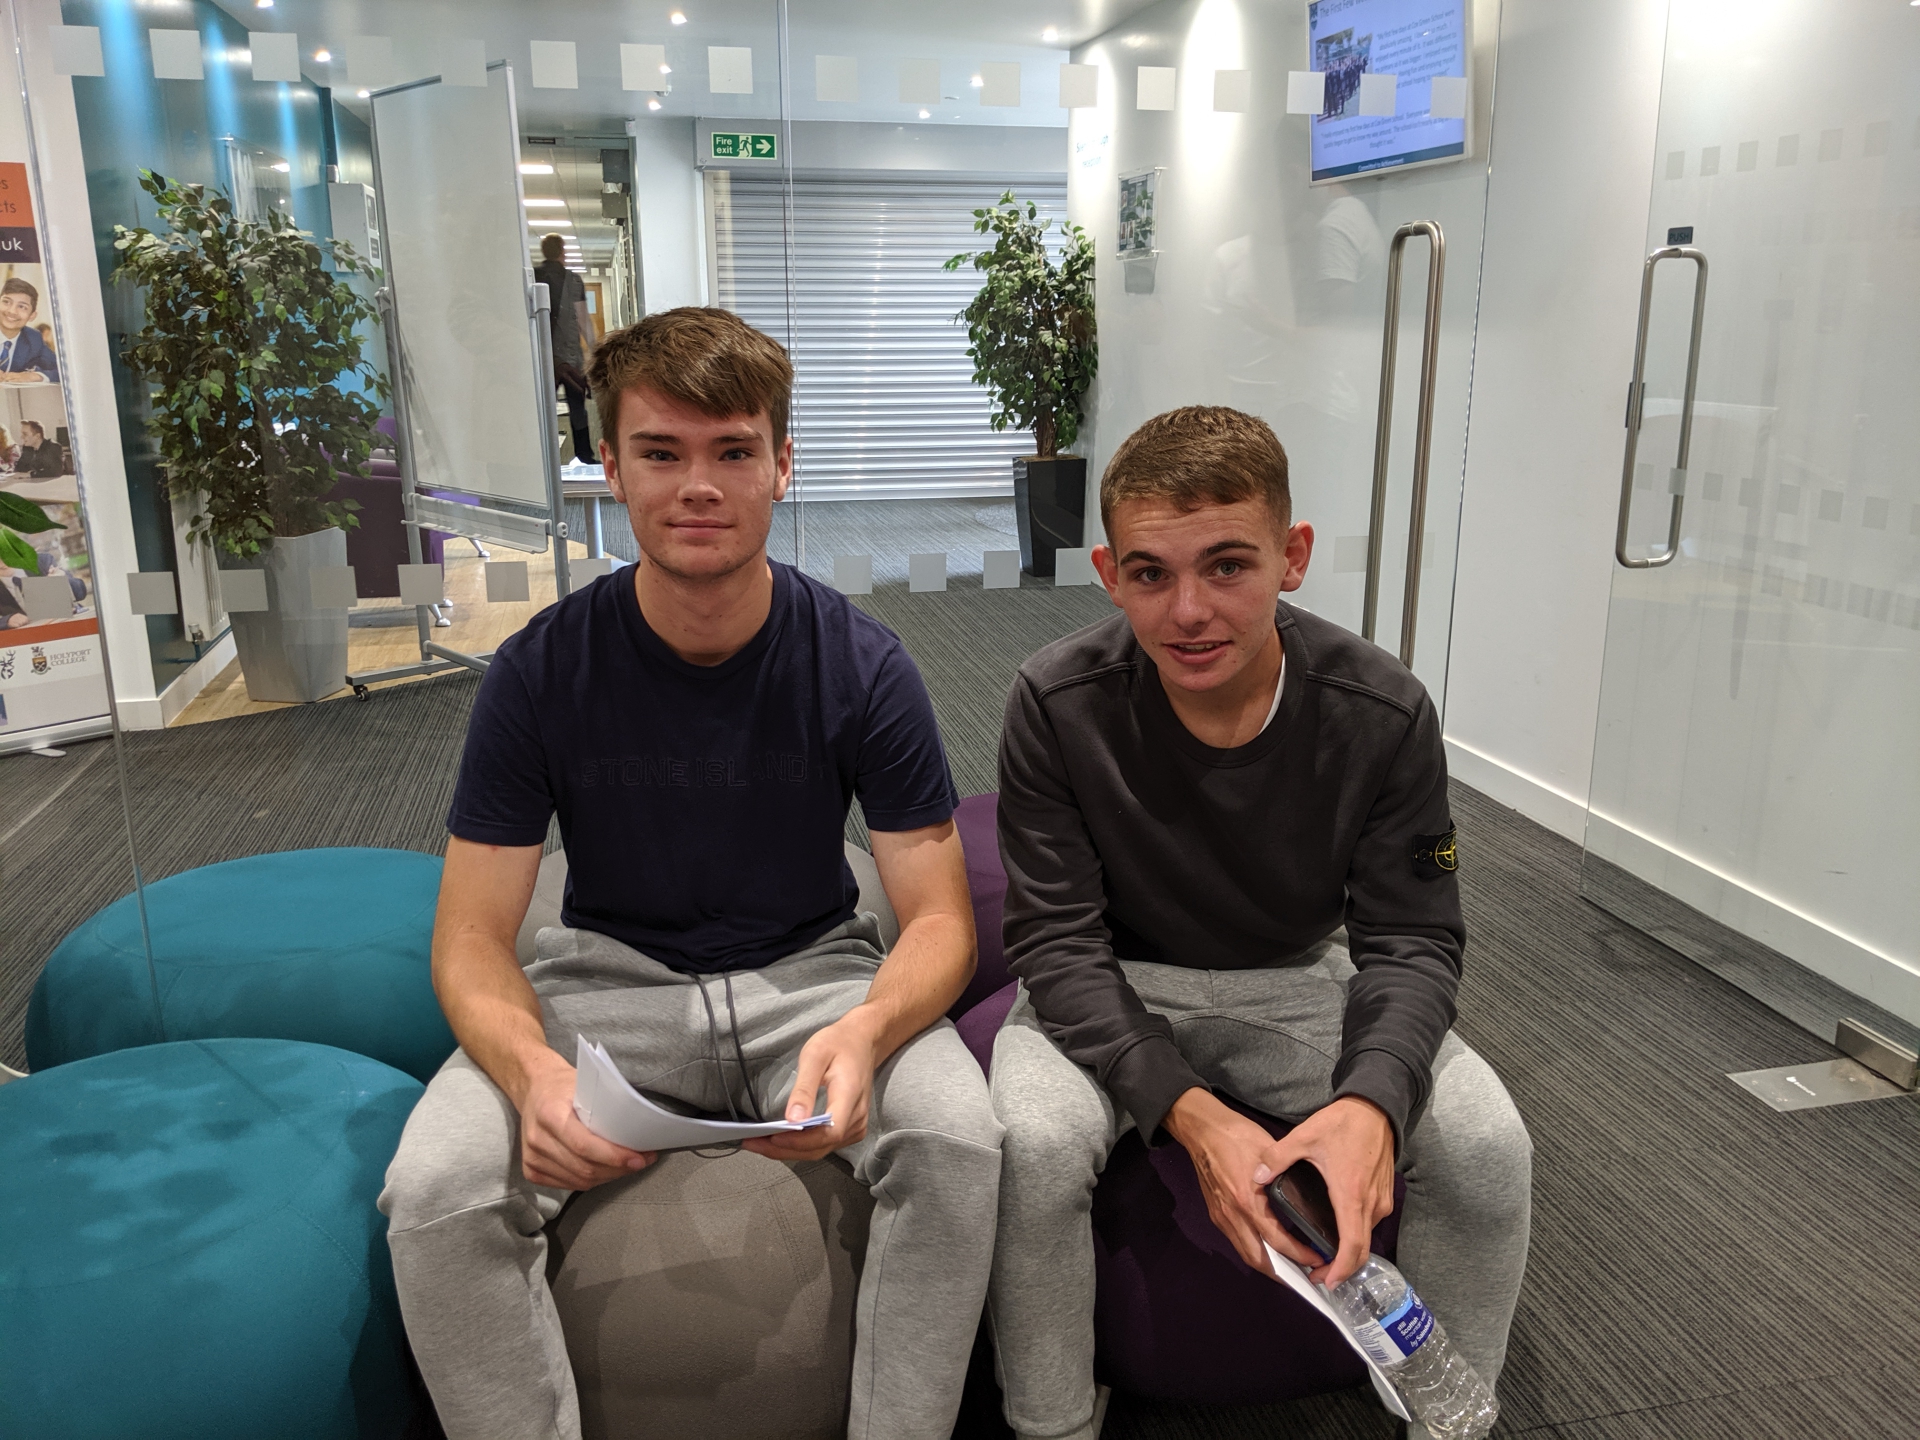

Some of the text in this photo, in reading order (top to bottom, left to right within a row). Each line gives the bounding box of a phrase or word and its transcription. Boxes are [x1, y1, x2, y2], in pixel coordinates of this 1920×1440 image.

[716, 137, 732, 145] Fire
[716, 146, 733, 154] exit
[1670, 232, 1690, 242] PUSH
[50, 649, 92, 661] HOLYPORT
[51, 656, 87, 667] COLLEGE
[582, 751, 808, 788] STONE ISLAND
[1401, 1316, 1419, 1336] Scottish
